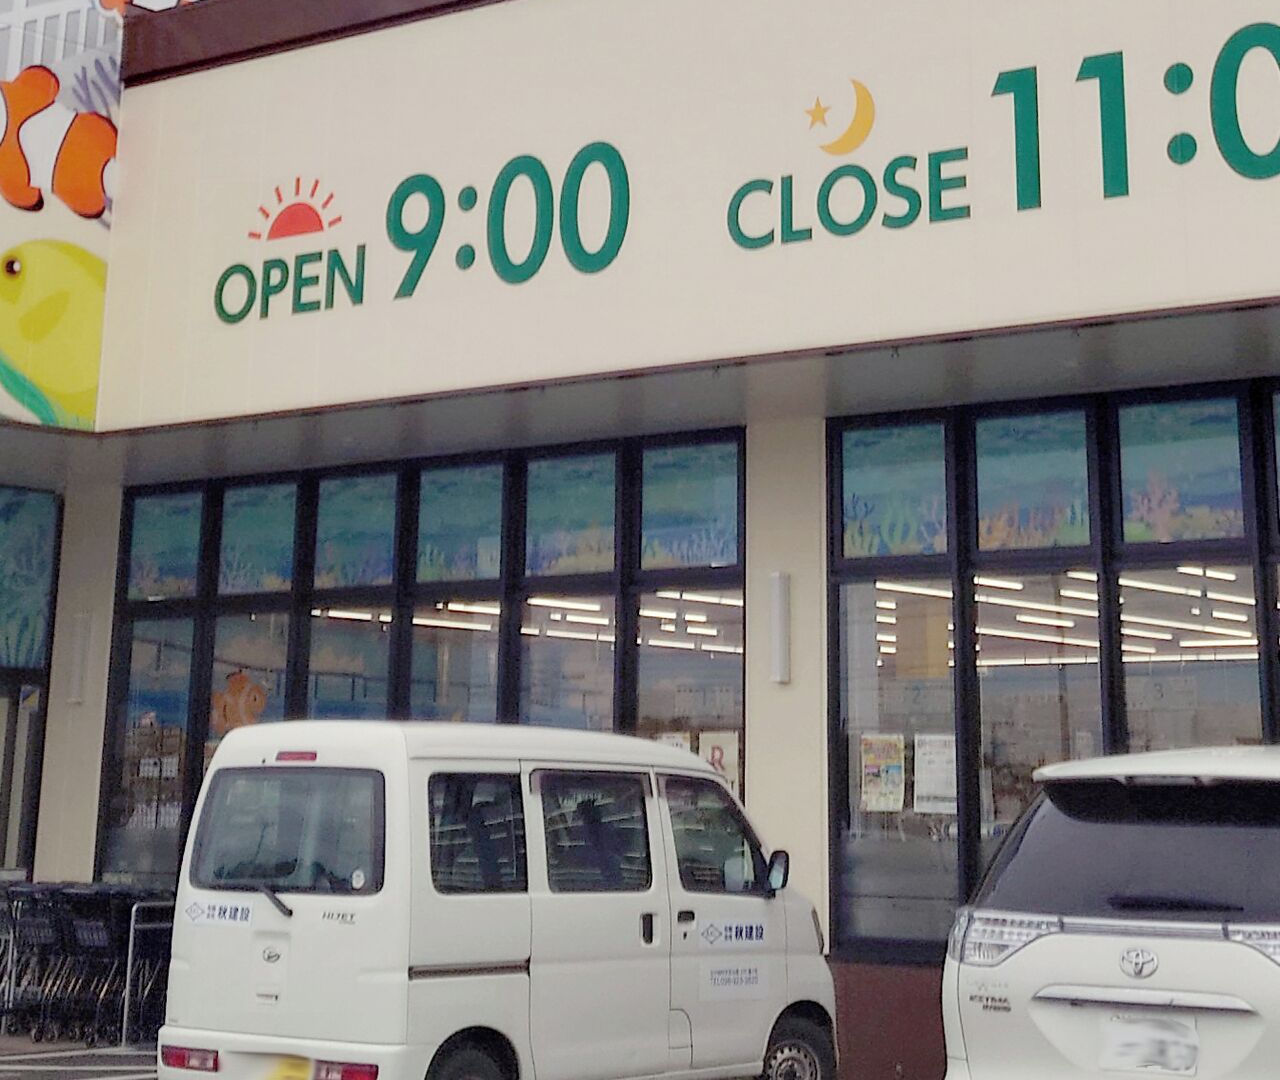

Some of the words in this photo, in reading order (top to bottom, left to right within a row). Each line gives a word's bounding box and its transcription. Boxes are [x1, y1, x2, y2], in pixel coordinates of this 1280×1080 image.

[213, 243, 368, 326] OPEN
[385, 141, 632, 301] 9:00
[726, 146, 971, 251] CLOSE
